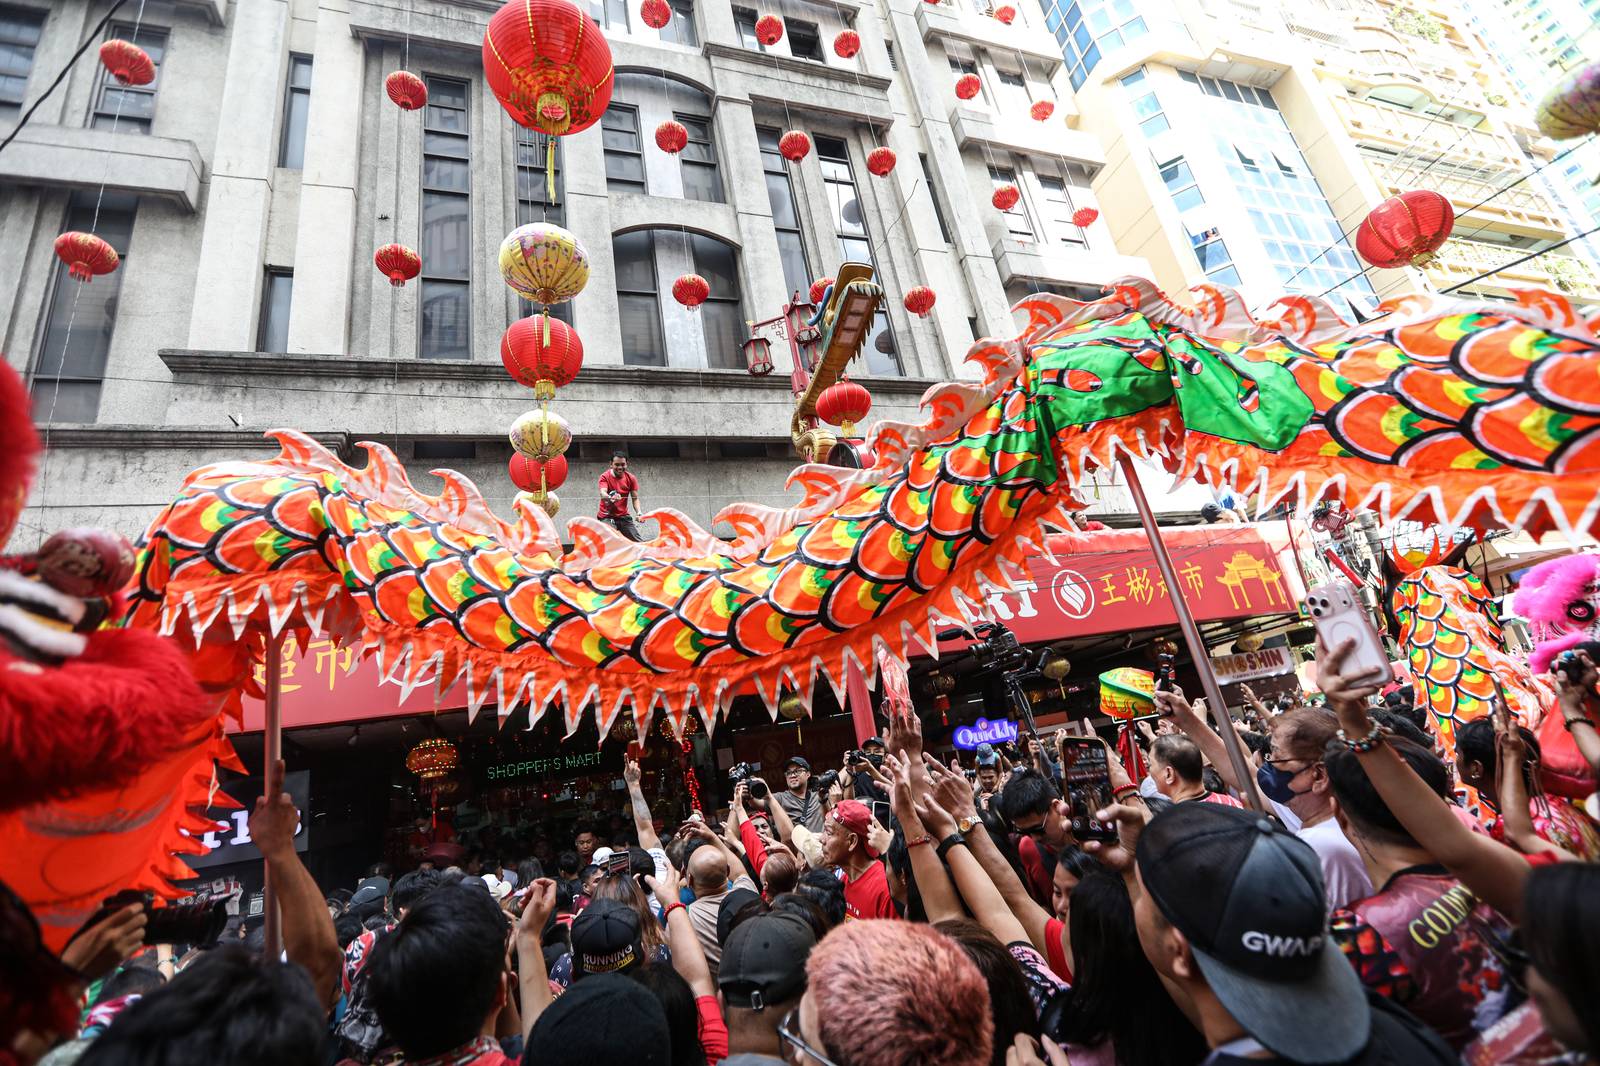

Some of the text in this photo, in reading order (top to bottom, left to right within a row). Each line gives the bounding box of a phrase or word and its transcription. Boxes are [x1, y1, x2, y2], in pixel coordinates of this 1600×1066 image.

[1100, 561, 1204, 606] 王彬市
[957, 720, 1018, 746] Quickly
[565, 752, 602, 769] MART
[582, 944, 634, 966] RUNNING
